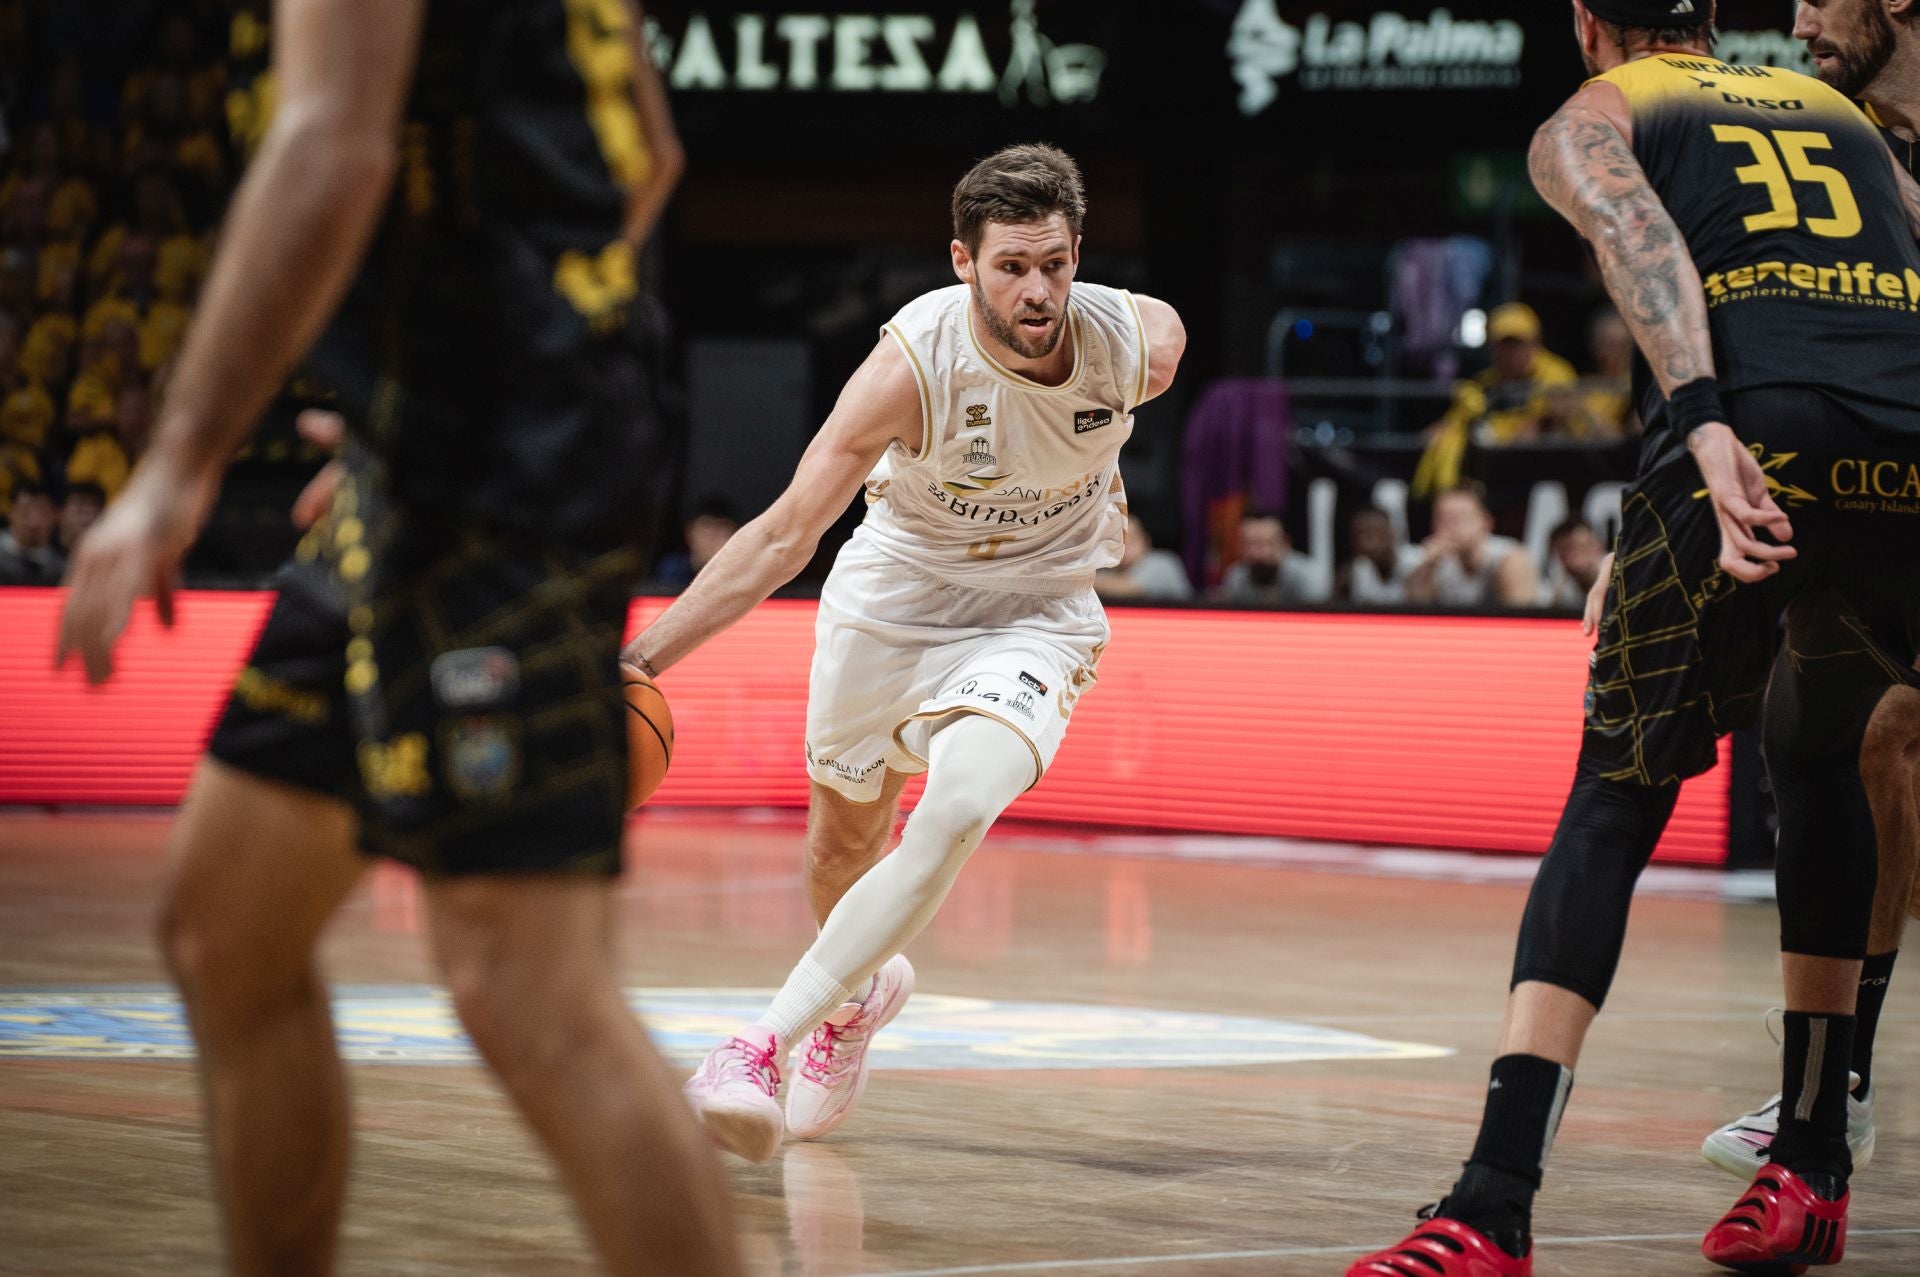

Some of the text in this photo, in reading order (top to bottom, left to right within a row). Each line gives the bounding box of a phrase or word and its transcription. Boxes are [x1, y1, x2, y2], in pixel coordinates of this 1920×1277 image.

[1303, 8, 1524, 66] La Palma
[670, 12, 998, 91] ALTESA
[1710, 124, 1863, 238] 35
[1808, 291, 1906, 310] emociones
[1077, 416, 1093, 426] liga
[1077, 418, 1110, 431] endesa
[1835, 499, 1880, 514] Canary
[1020, 675, 1041, 692] acb
[854, 766, 861, 777] Y
